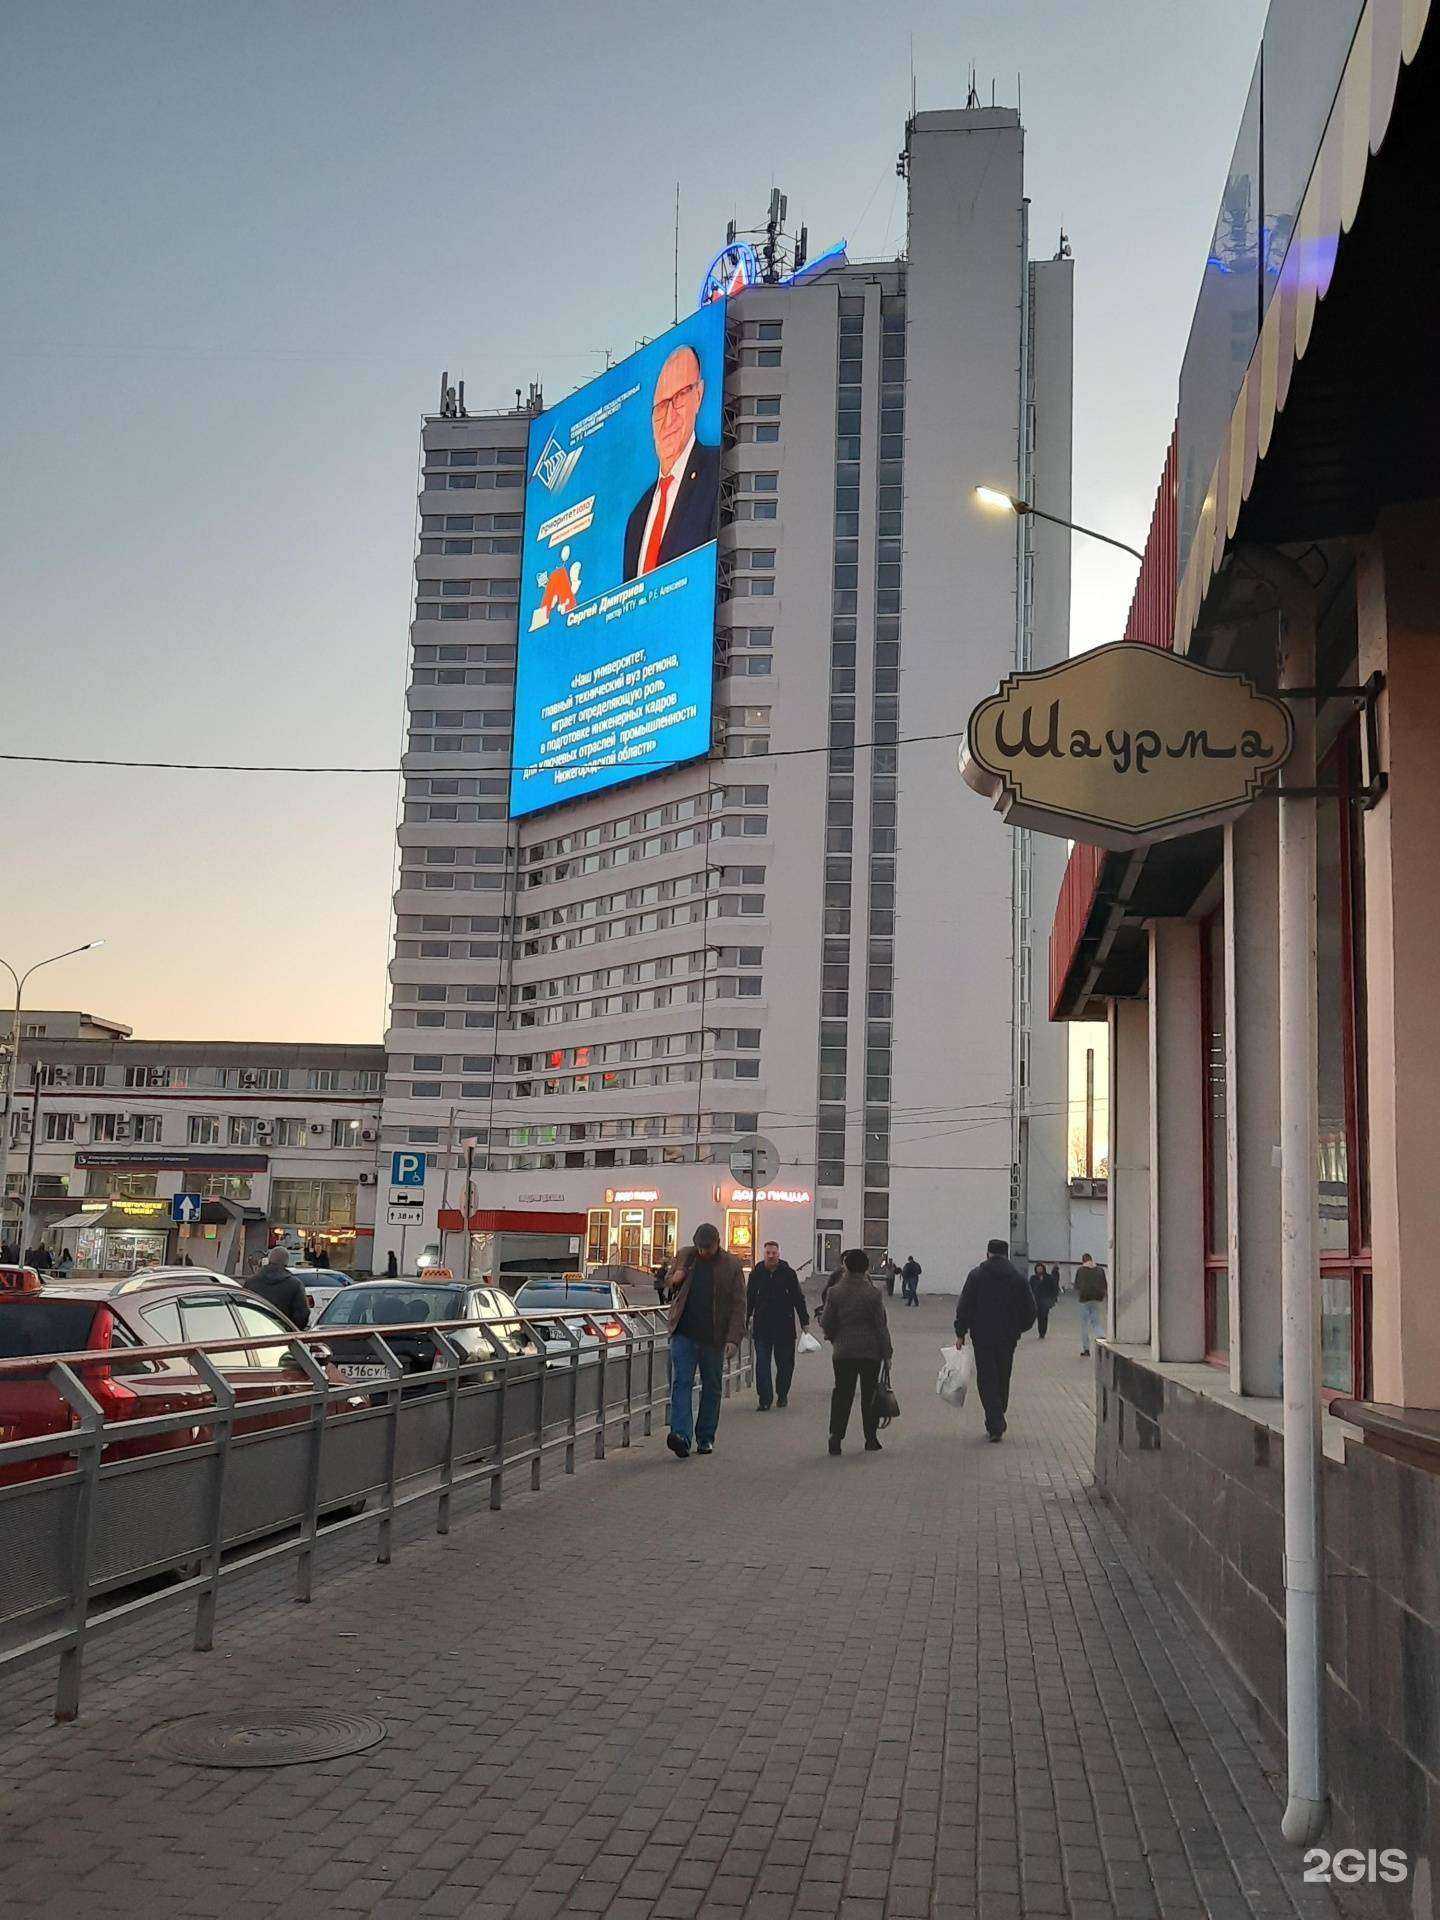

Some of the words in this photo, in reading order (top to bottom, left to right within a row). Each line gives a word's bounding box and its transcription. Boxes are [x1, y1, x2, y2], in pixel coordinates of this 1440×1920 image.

[566, 603, 598, 626] Сергей
[599, 582, 645, 615] Дмитриев
[541, 694, 573, 719] главный
[574, 673, 624, 706] технический
[626, 670, 641, 686] вуз
[642, 654, 679, 680] региона,
[593, 649, 646, 684] университет,
[540, 743, 546, 754] в
[546, 726, 590, 751] подготовке
[591, 706, 643, 735] инженерных
[645, 693, 677, 715] кадров
[551, 713, 577, 733] играет
[578, 687, 643, 722] определяющую
[643, 679, 666, 699] роль
[538, 748, 577, 771] ключевых
[578, 732, 616, 757] отраслей
[620, 705, 697, 744] промышленности
[995, 698, 1273, 774] Шаурма
[554, 750, 616, 784] Нижегородской
[617, 740, 657, 761] области»
[398, 1154, 419, 1182] P
[767, 1190, 811, 1203] ПИЦЦА
